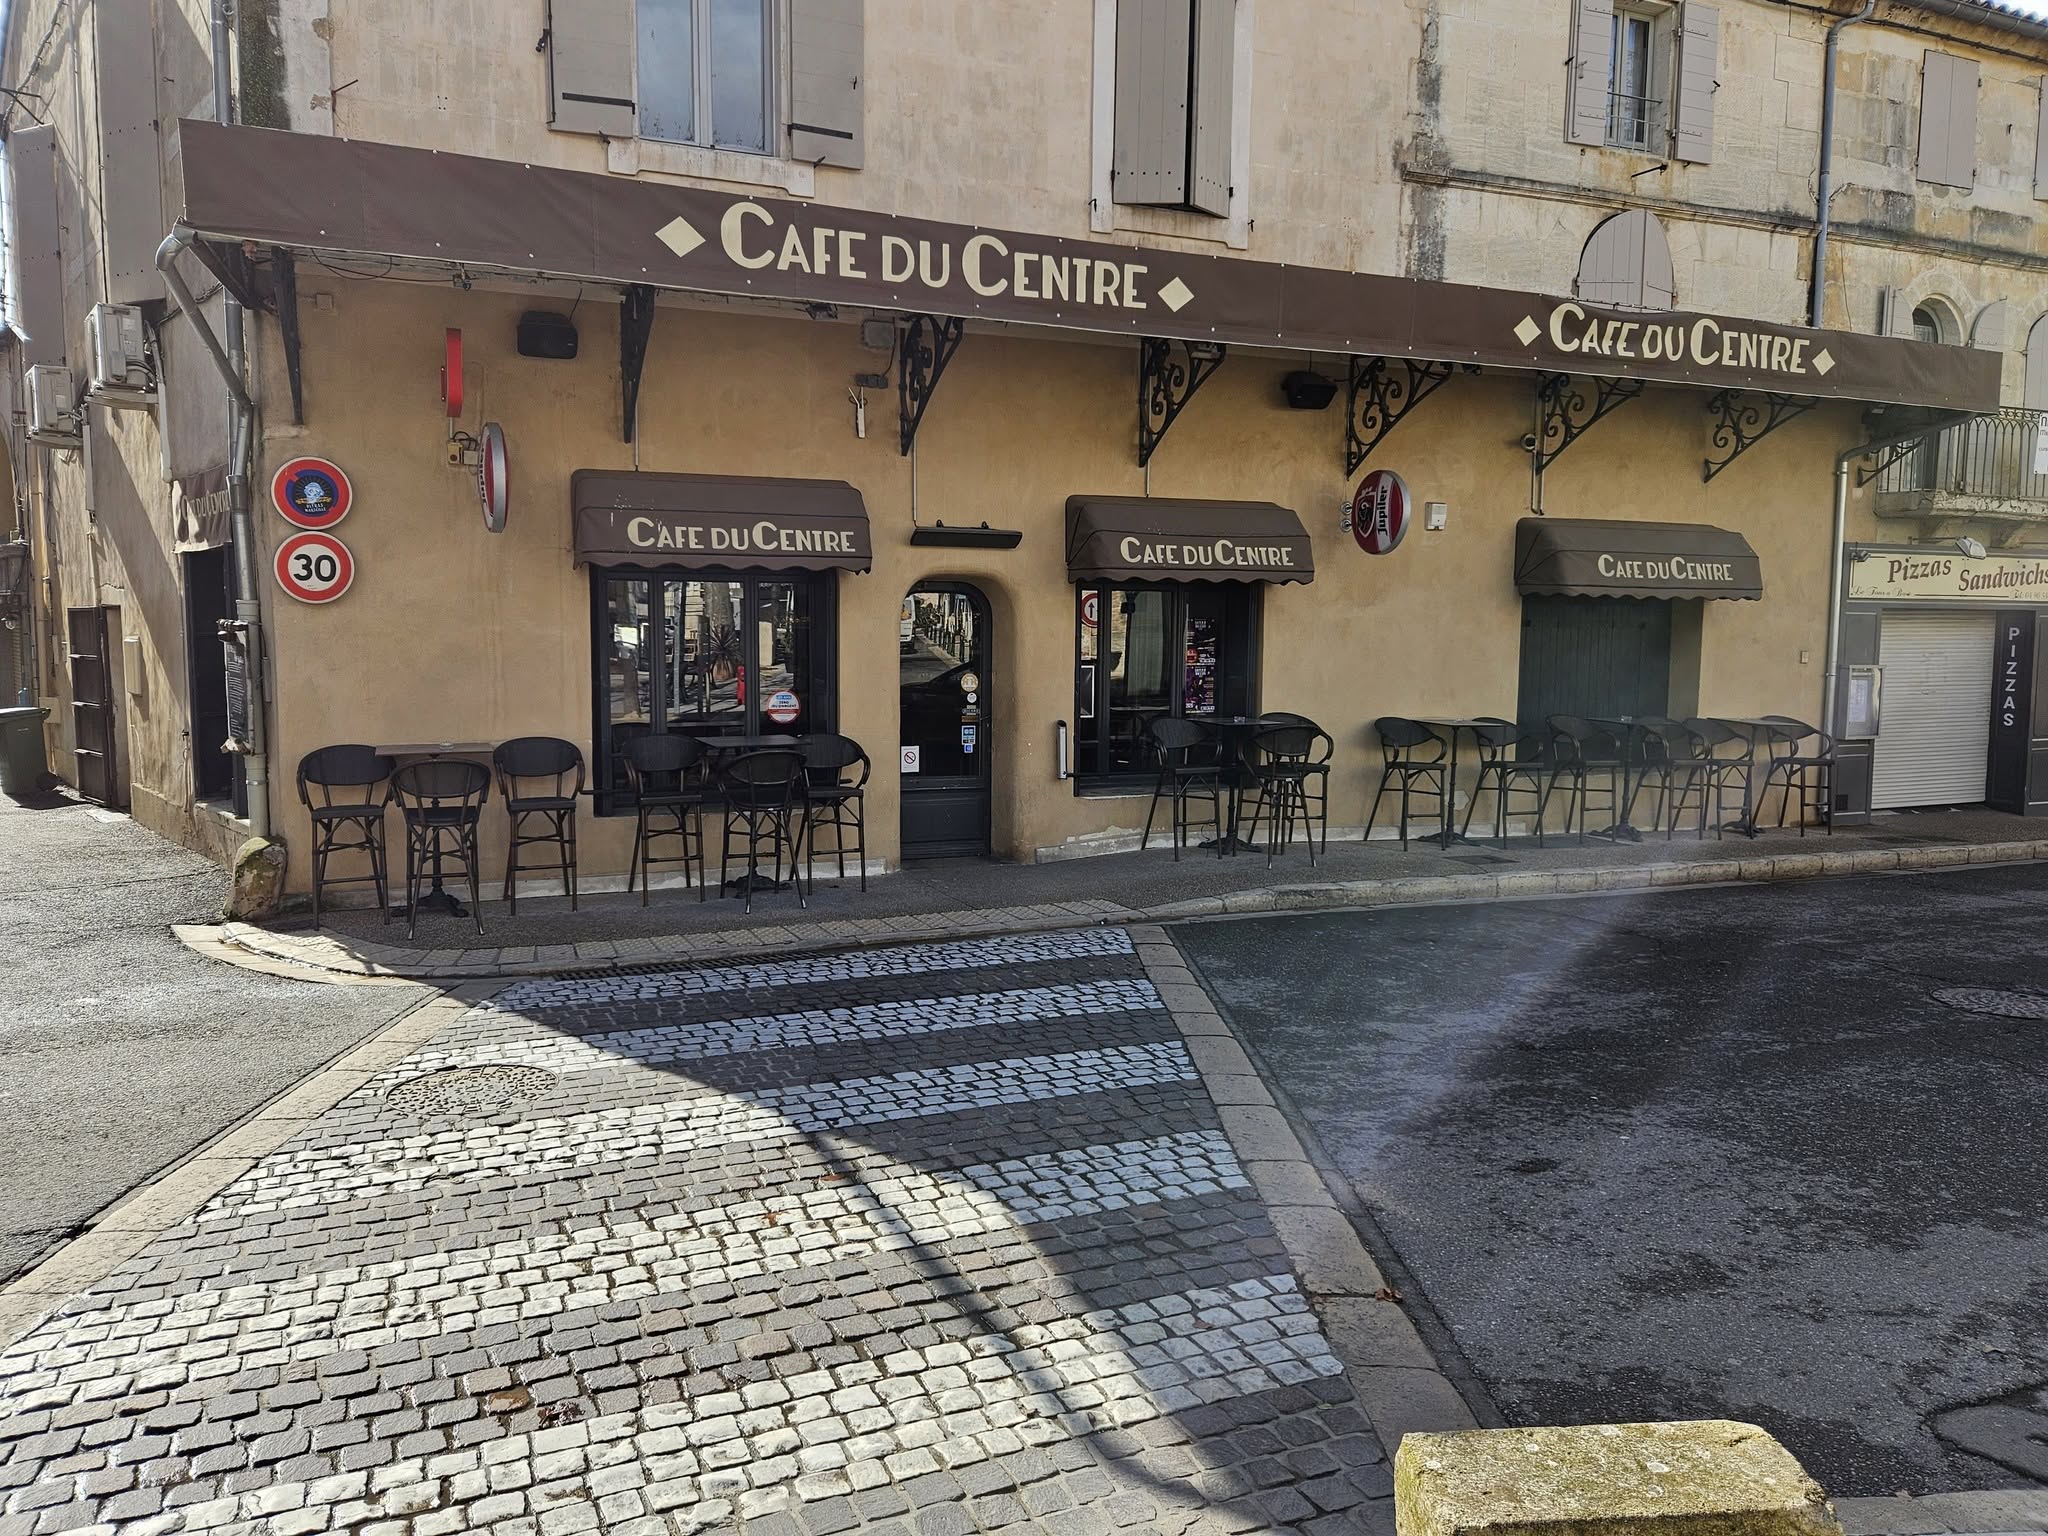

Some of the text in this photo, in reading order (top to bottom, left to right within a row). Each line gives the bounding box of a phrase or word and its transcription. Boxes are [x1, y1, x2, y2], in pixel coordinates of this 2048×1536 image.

[720, 201, 1149, 309] CAFE DU CENTRE
[1549, 302, 1810, 374] CAFE DU CENTRE
[1377, 485, 1389, 537] Jupiler
[627, 516, 856, 553] CAFE DU CENTRE
[1120, 536, 1294, 566] CAFE DU CENTRE
[293, 553, 337, 582] 30
[1597, 554, 1734, 581] CAFE DU CENTRE
[1887, 557, 2048, 592] Pizzas Sandwichs
[2003, 627, 2020, 727] PIZZAS
